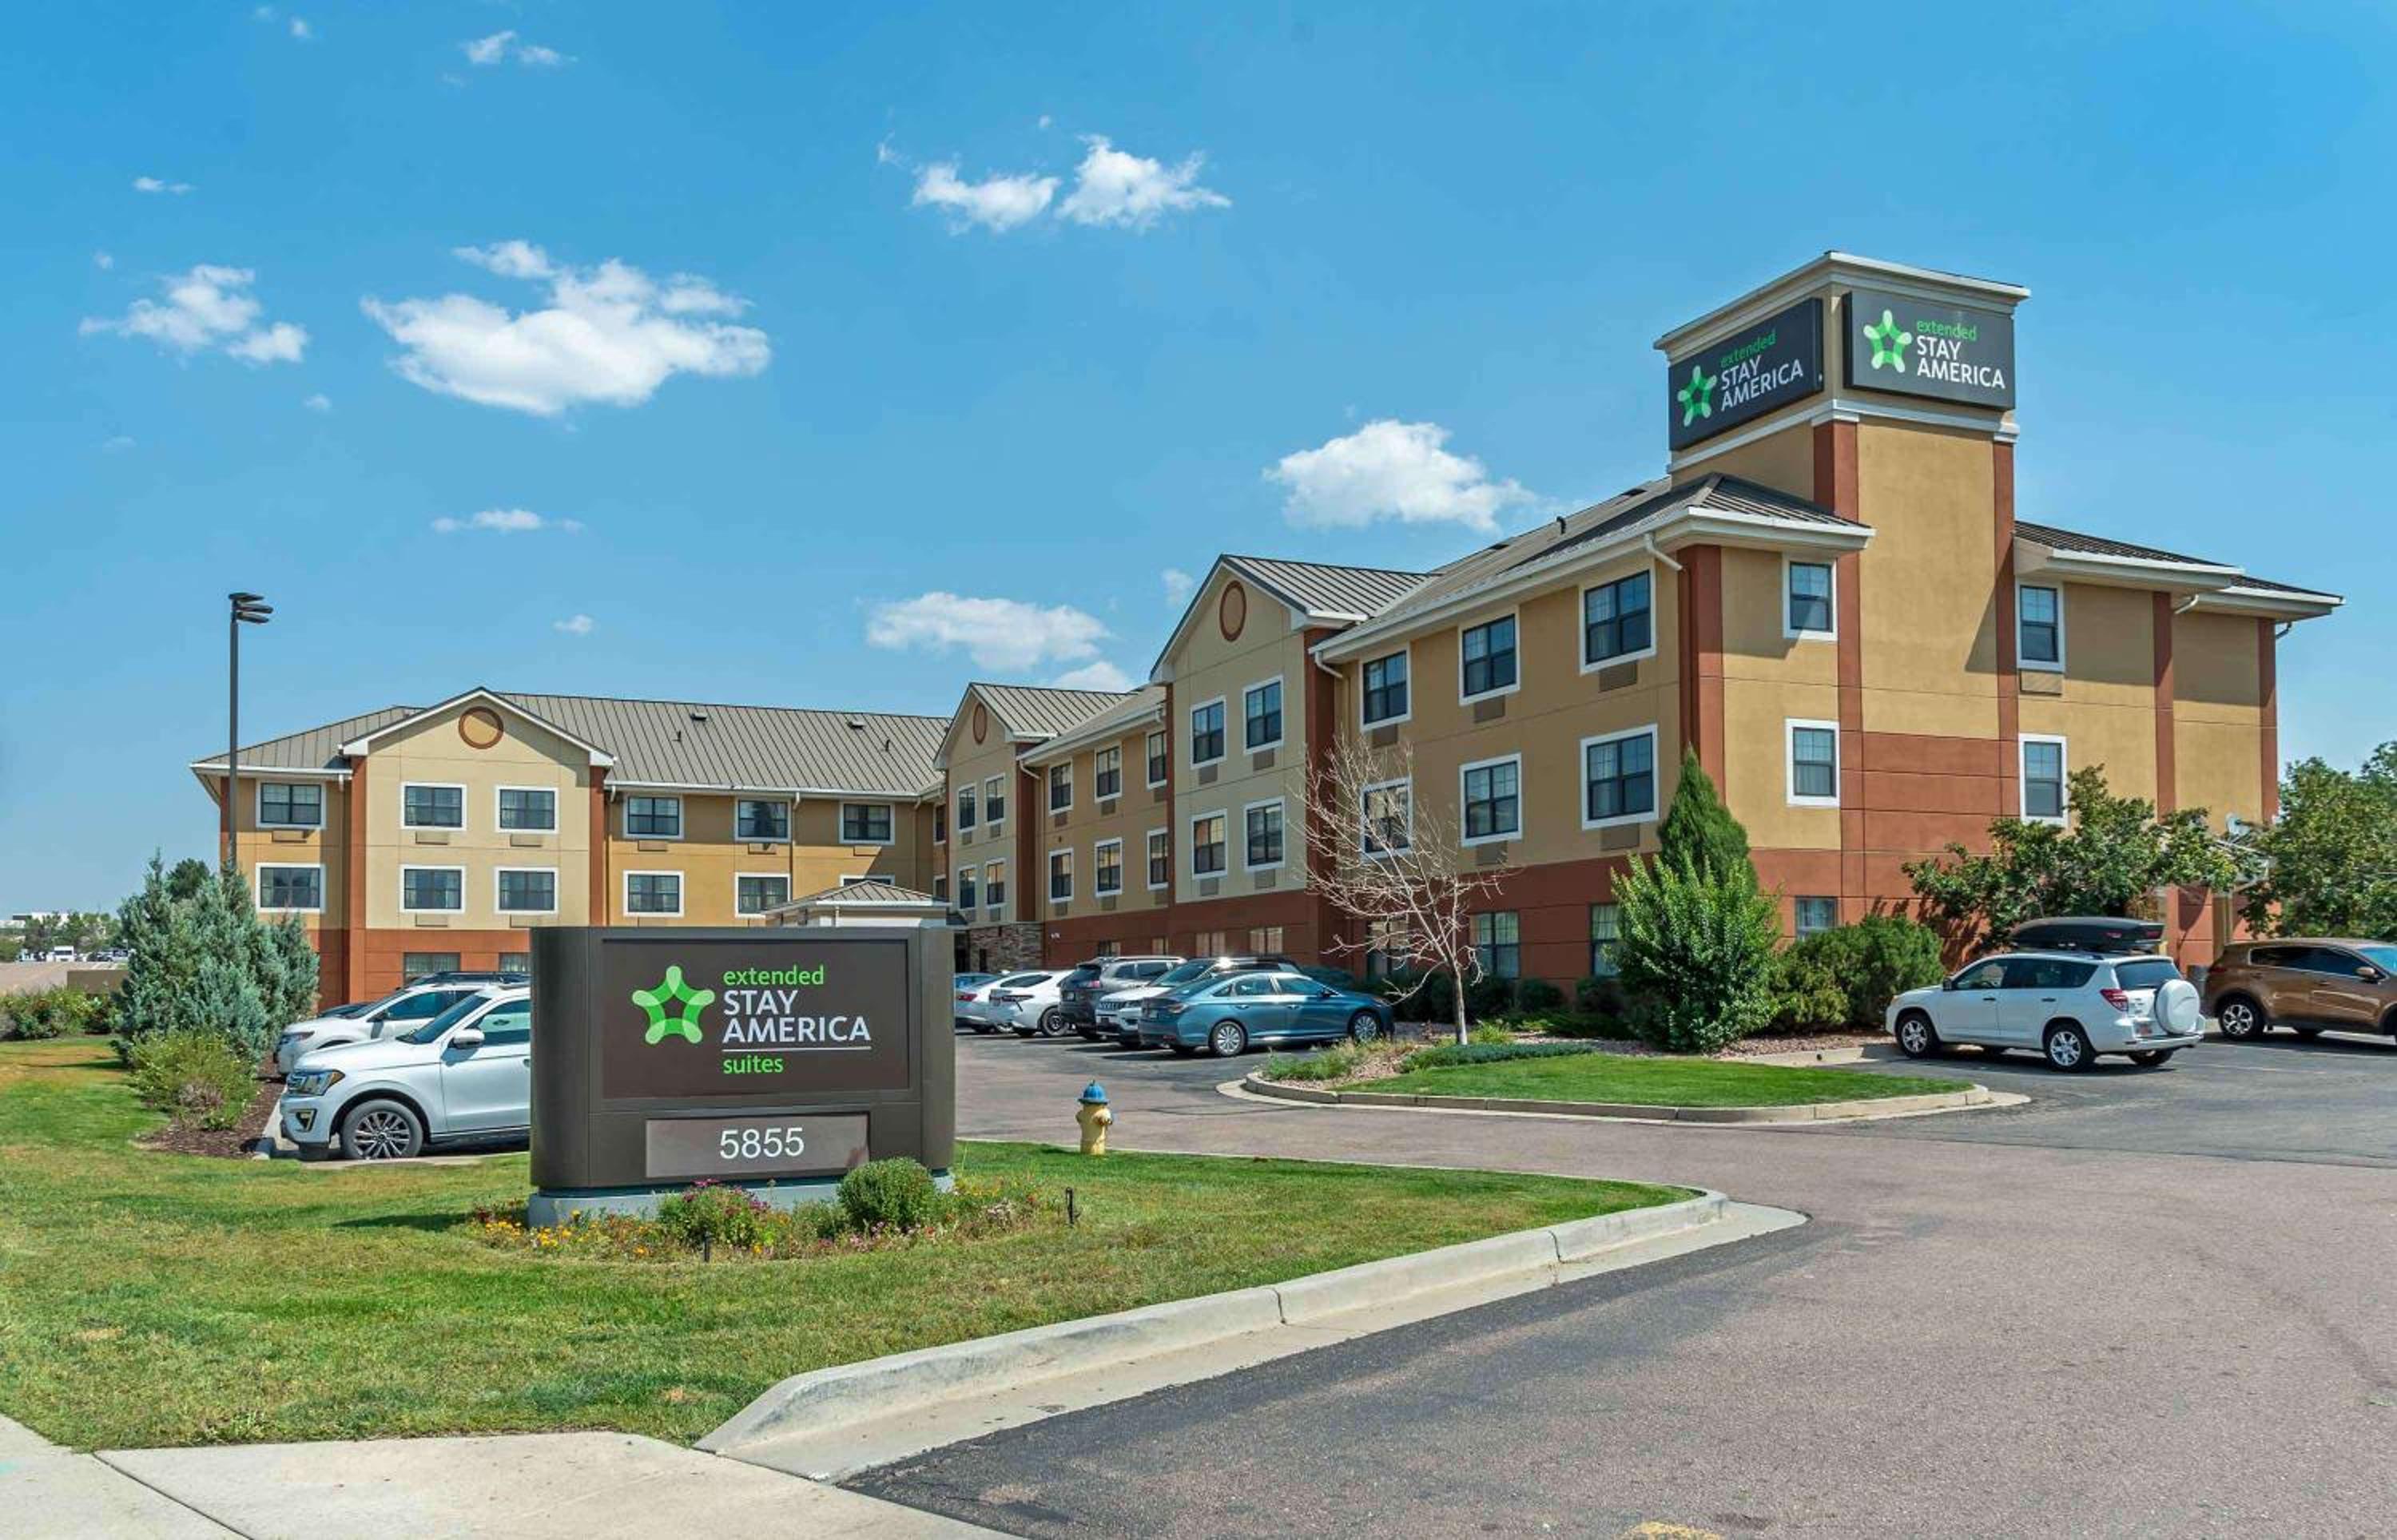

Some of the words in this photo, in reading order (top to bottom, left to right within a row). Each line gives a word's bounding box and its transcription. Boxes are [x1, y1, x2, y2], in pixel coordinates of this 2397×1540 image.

[1917, 320, 1977, 342] extended
[1720, 330, 1776, 367] extended
[1917, 335, 1961, 360] STAY
[1721, 355, 1761, 390] STAY
[1721, 359, 1803, 411] AMERICA
[1917, 357, 2005, 389] AMERICA
[723, 964, 825, 986] extended
[723, 990, 798, 1015] STAY
[722, 1016, 872, 1043] AMERICA
[723, 1054, 784, 1074] suites
[719, 1127, 804, 1159] 5855
